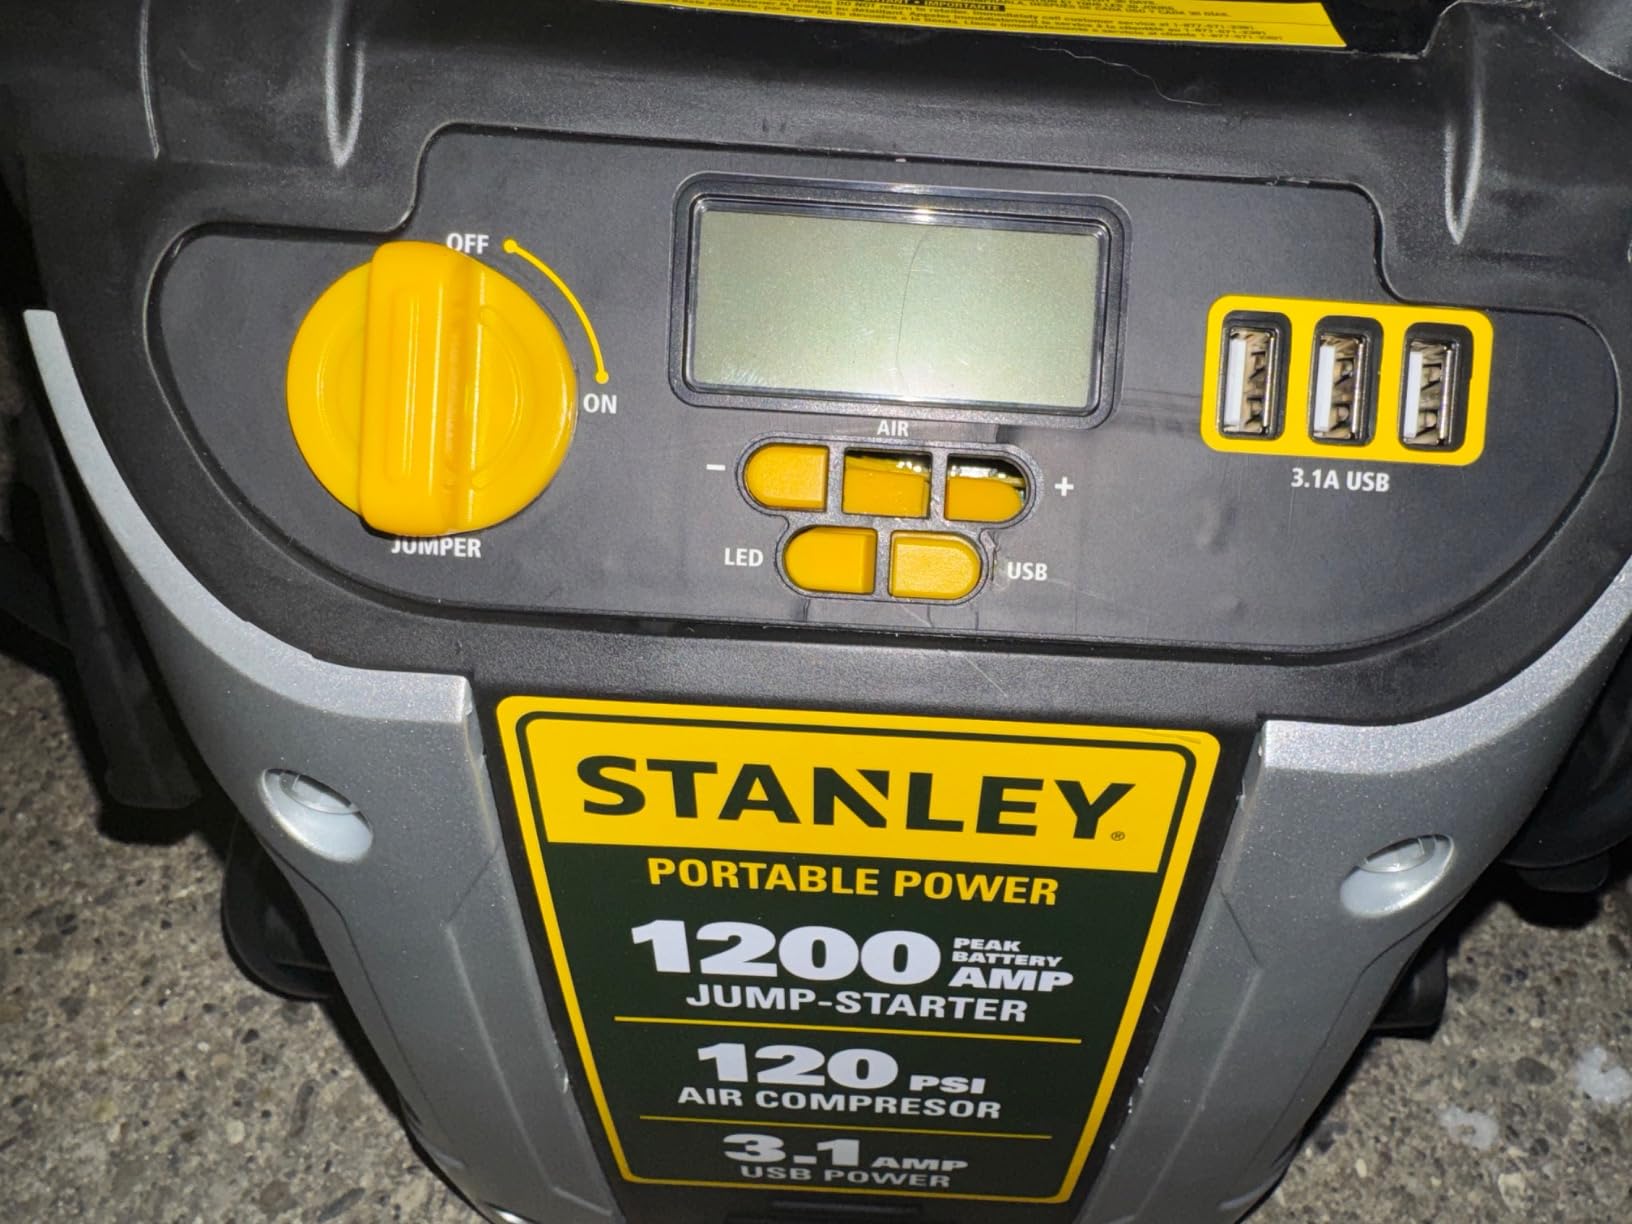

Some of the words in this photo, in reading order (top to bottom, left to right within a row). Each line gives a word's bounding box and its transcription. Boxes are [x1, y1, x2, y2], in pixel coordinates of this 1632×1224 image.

[446, 233, 490, 255] OFF
[583, 393, 617, 414] ON
[876, 419, 910, 437] AIR
[1290, 467, 1340, 490] 3.1A
[1347, 470, 1391, 493] USB
[391, 536, 482, 559] JUMPER
[724, 547, 764, 568] LED
[1006, 562, 1048, 582] USB
[576, 755, 1136, 840] STANLEY
[648, 857, 880, 897] PORTABLE
[894, 870, 1059, 906] POWER
[631, 919, 942, 986] 1200
[953, 937, 1021, 952] PEAK
[952, 951, 1064, 968] BATTERY
[948, 967, 1075, 993] AMP
[686, 983, 1029, 1023] JUMP-STARTER
[697, 1042, 899, 1089] 120
[909, 1074, 986, 1095] PSI
[678, 1086, 743, 1107] AIR
[755, 1090, 1002, 1120] COMPRESOR
[723, 1133, 860, 1167] 3.1
[871, 1156, 969, 1172] AMP
[740, 1165, 813, 1182] USB
[824, 1168, 952, 1189] POWER
